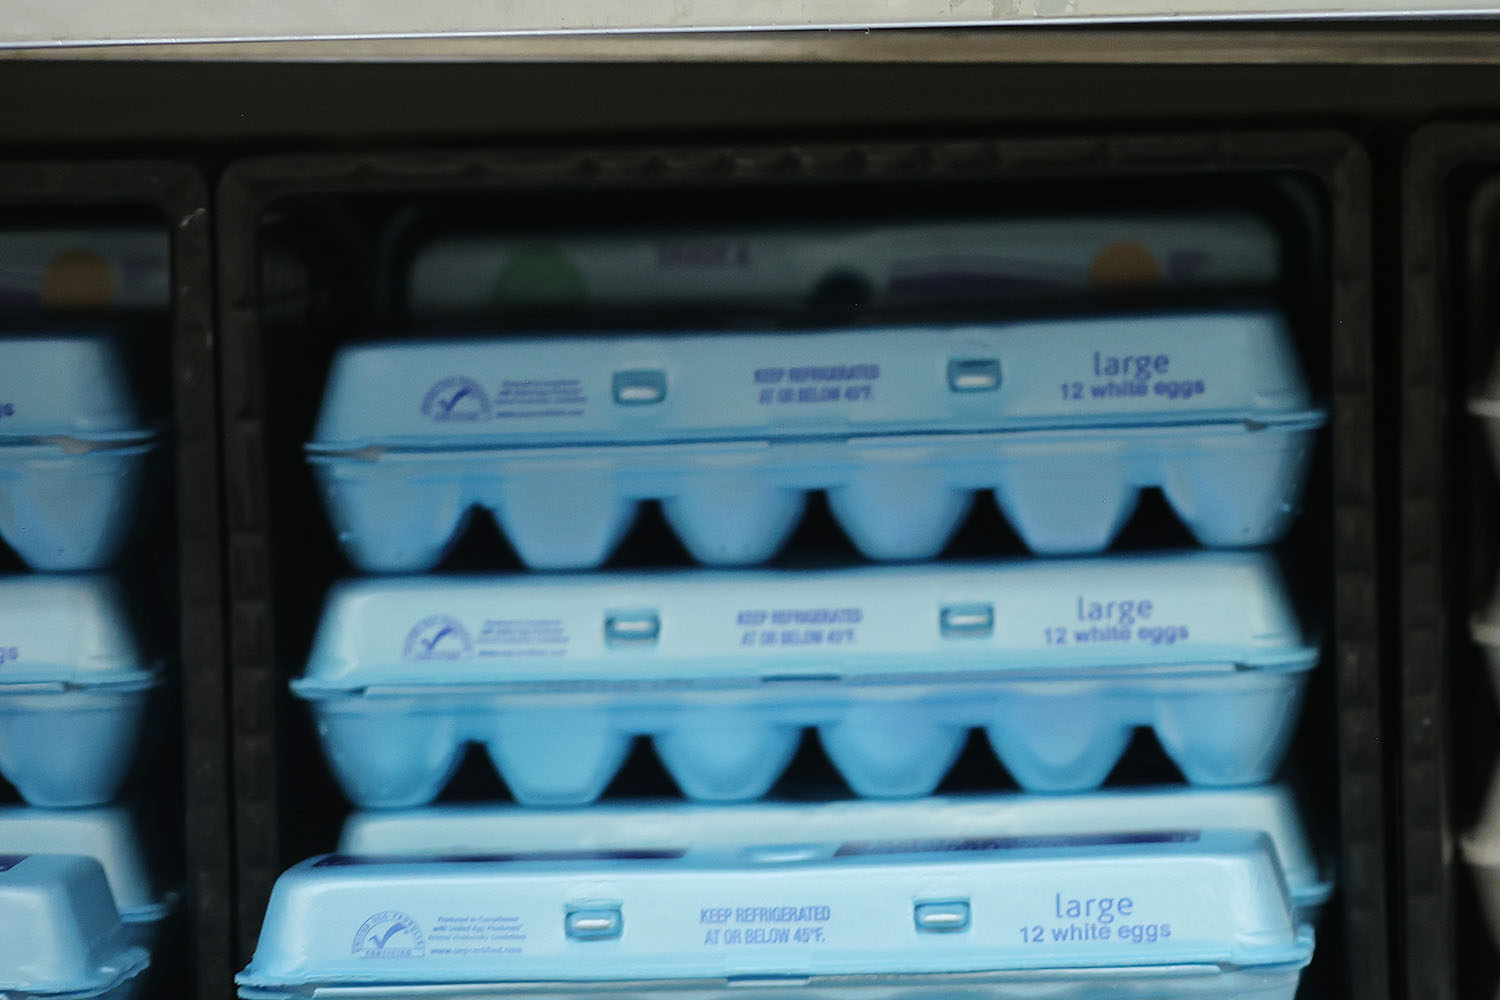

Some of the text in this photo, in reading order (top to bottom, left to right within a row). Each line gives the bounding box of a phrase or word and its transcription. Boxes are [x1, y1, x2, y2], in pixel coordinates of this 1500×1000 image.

[1094, 352, 1169, 381] large
[1061, 380, 1205, 400] 12 white eggs
[1078, 596, 1153, 625] large
[1045, 625, 1189, 645] 12 white eggs
[700, 906, 831, 924] KEEP REFRIGERATED
[1056, 893, 1133, 925] large
[704, 929, 720, 945] AT
[724, 928, 741, 944] OR
[745, 928, 790, 944] BELOW
[1020, 924, 1171, 944] 12 white eggs
